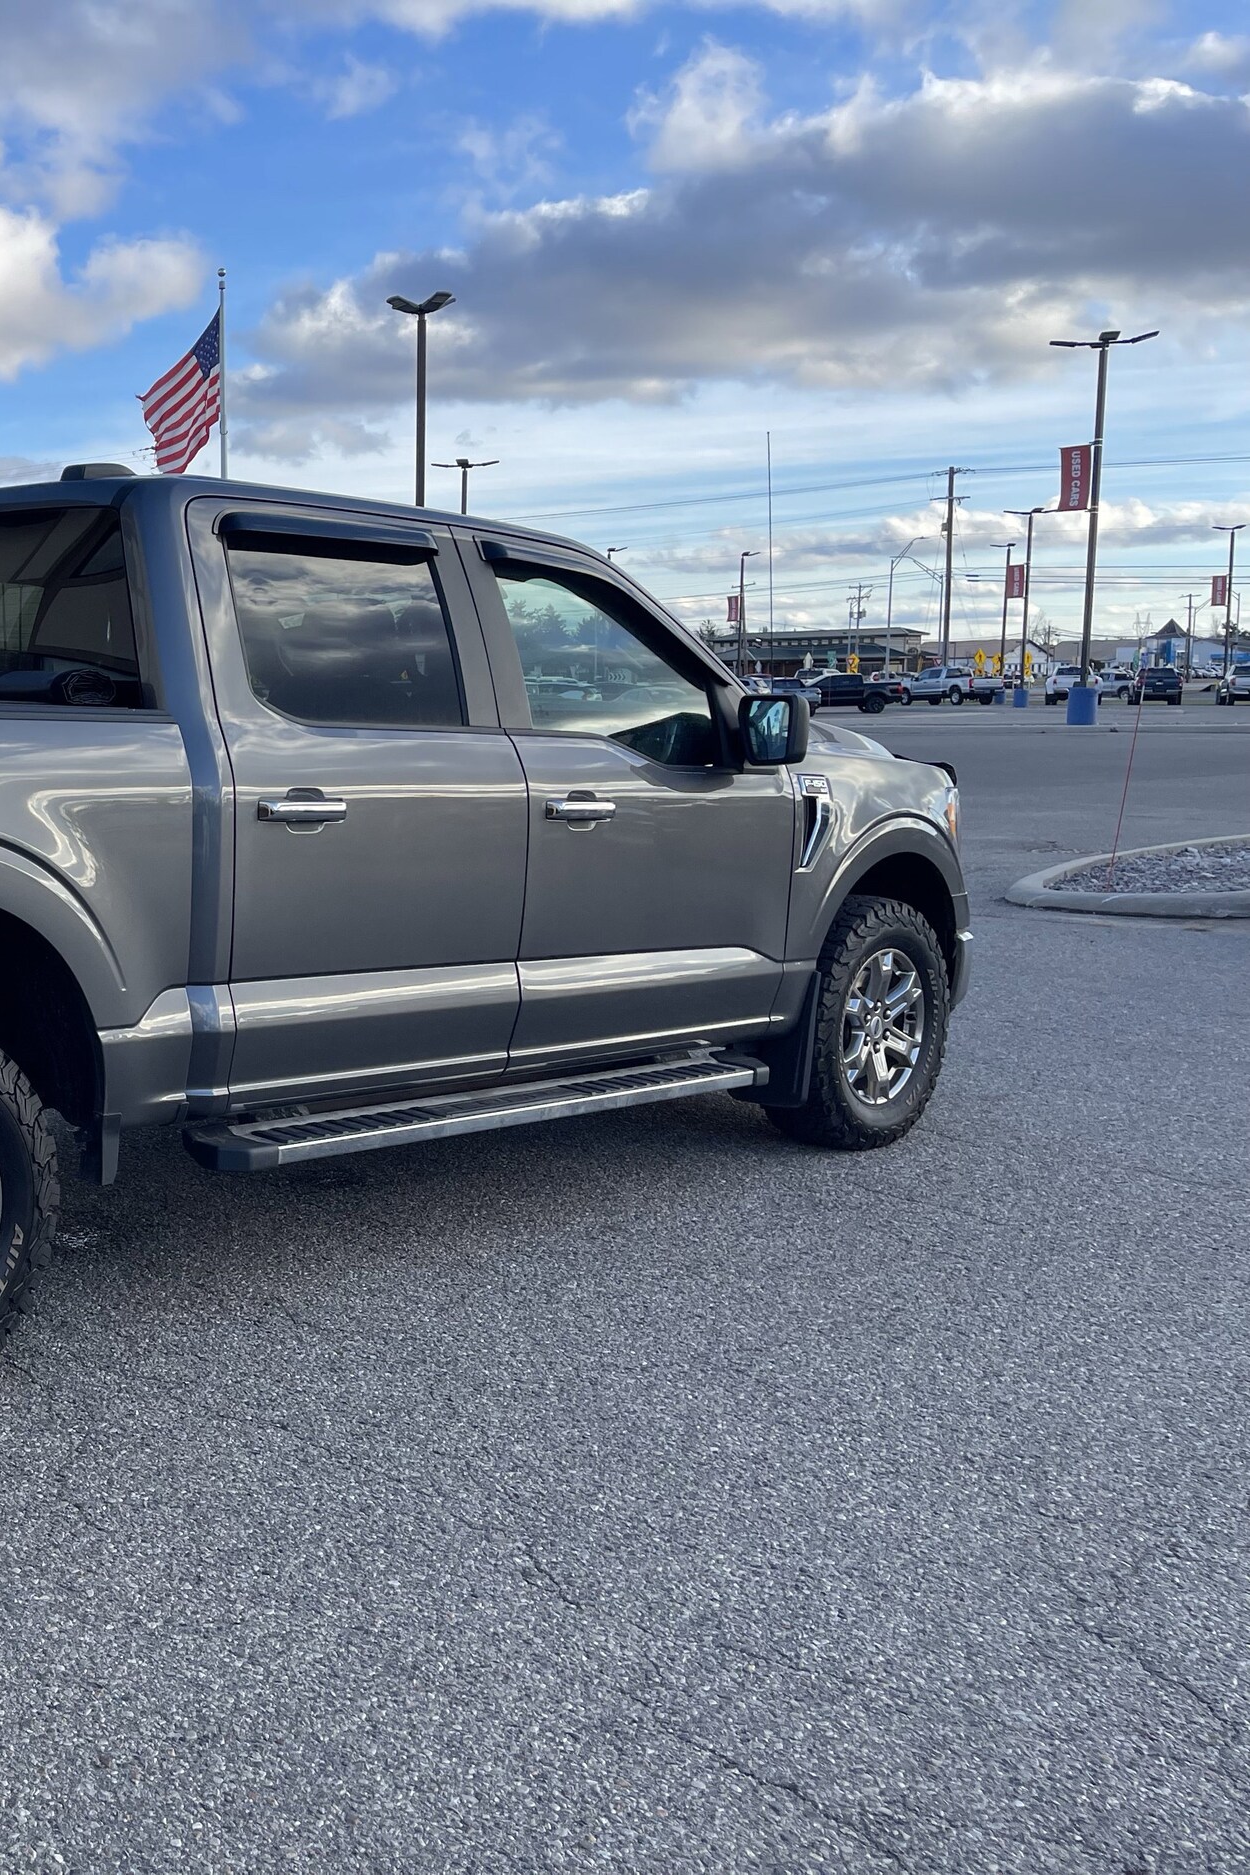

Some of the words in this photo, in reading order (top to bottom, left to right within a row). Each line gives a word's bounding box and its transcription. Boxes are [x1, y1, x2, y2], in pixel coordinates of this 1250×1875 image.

[1071, 451, 1081, 478] USED
[1069, 480, 1081, 507] CARS
[804, 779, 827, 788] F-150
